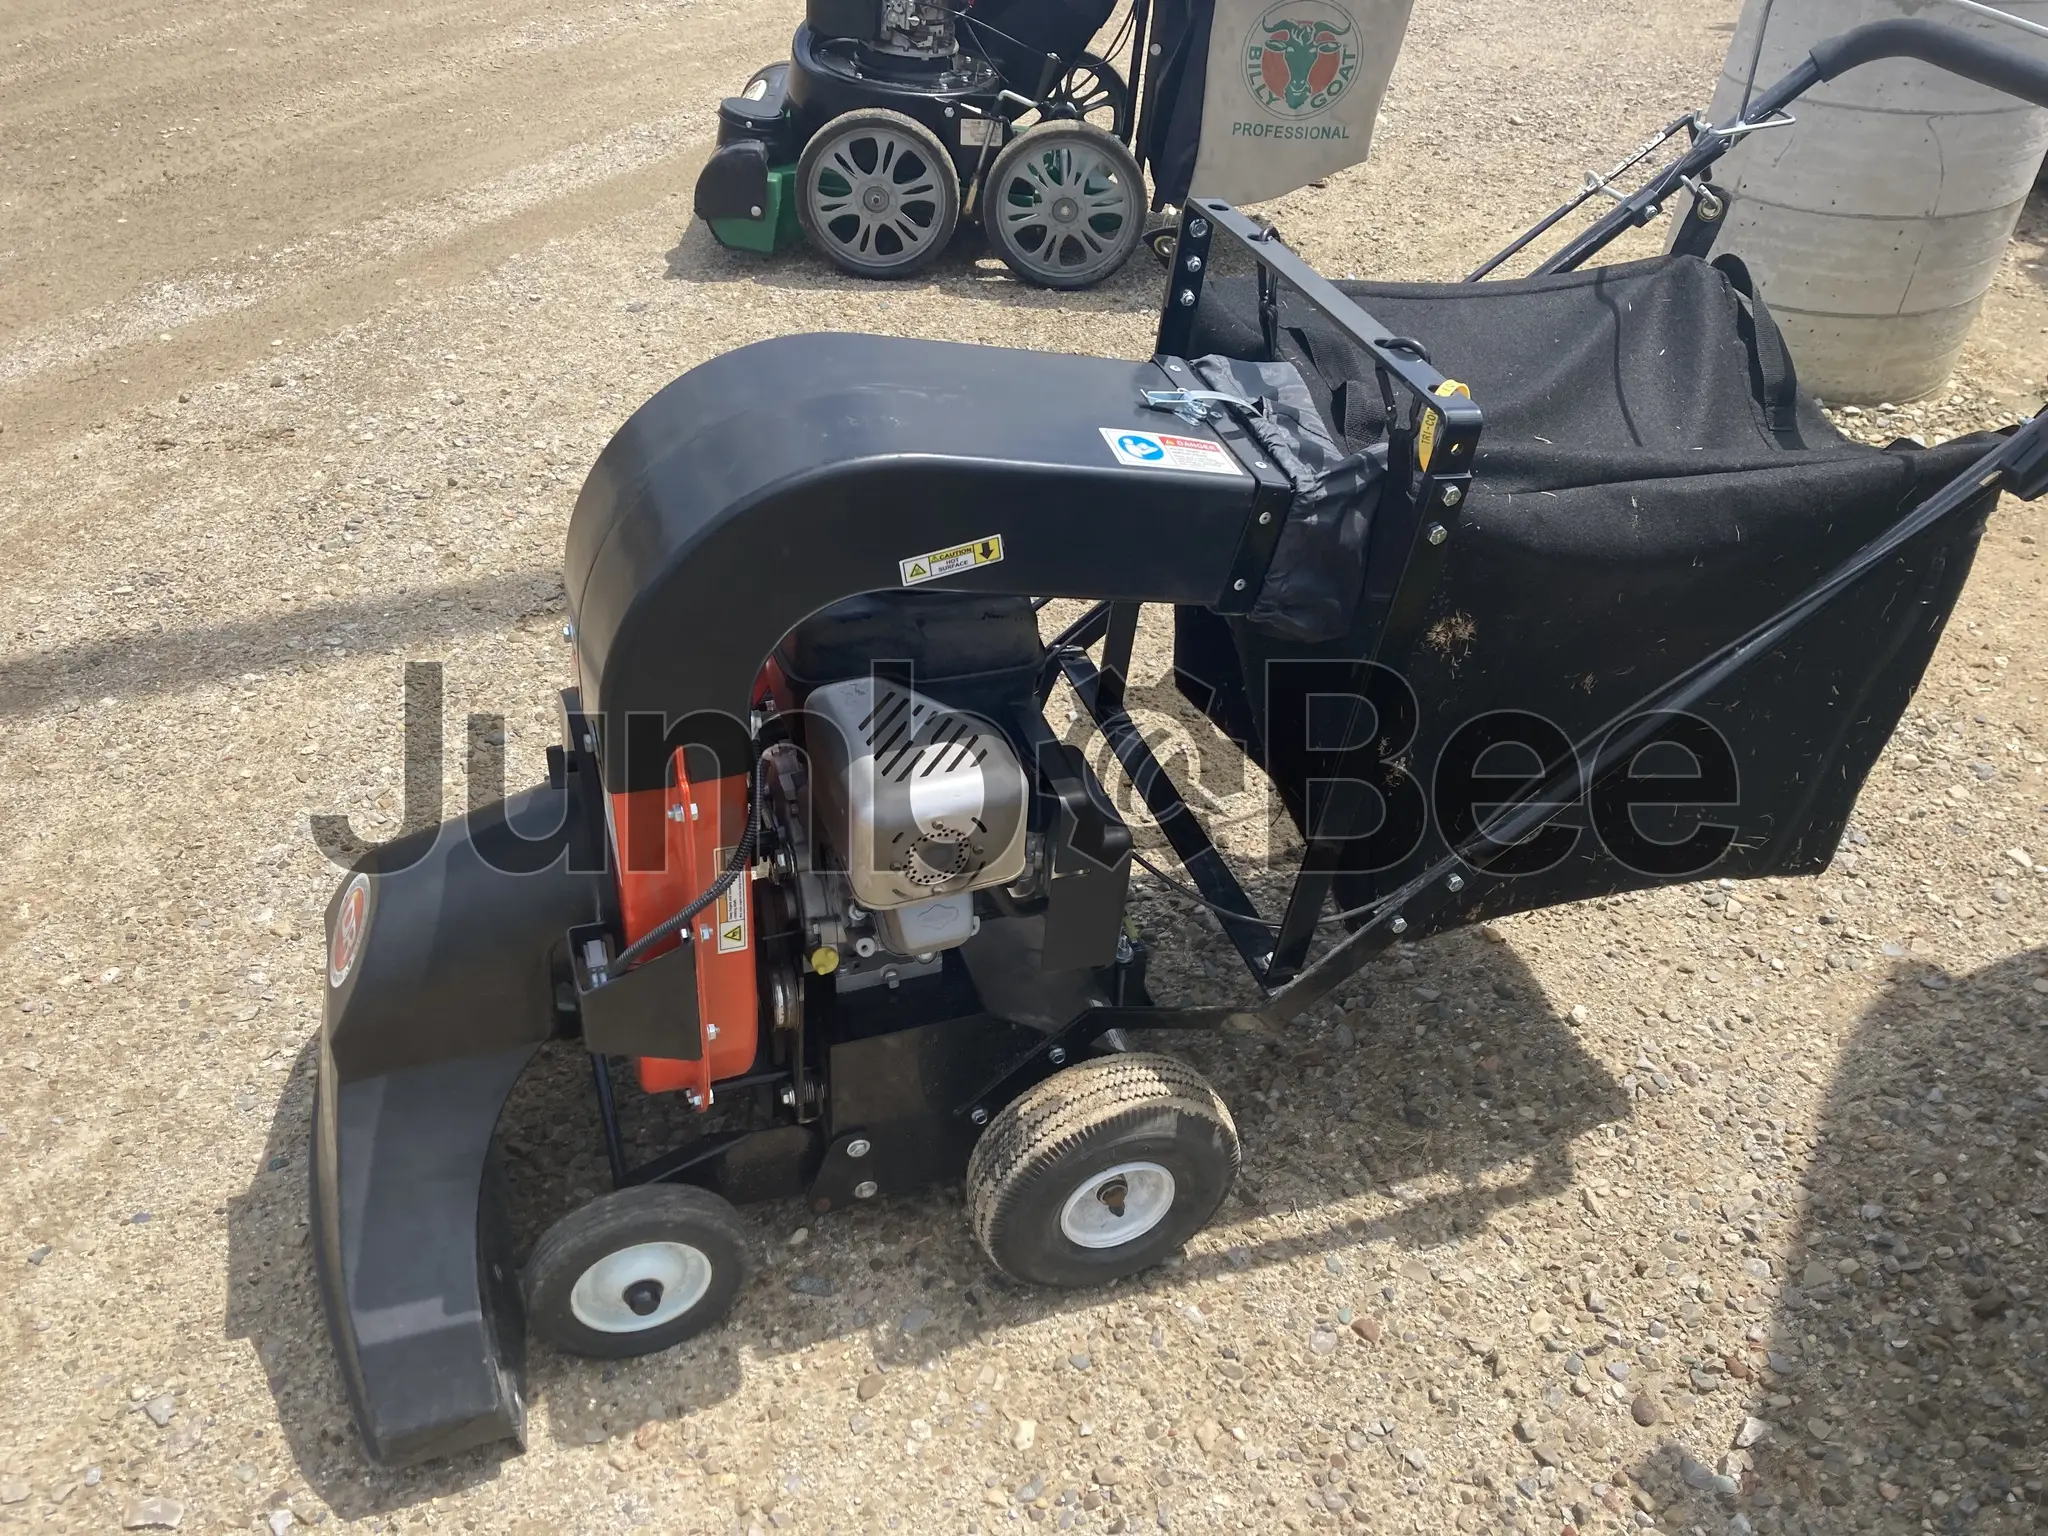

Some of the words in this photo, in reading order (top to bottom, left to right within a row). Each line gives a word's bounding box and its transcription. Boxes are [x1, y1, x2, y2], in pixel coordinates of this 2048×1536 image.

[1248, 46, 1281, 106] BILLY
[1310, 48, 1356, 109] GOAT
[1232, 122, 1350, 139] PROFESSIONAL
[939, 547, 972, 560] CAUTION
[938, 561, 968, 572] SURFACE
